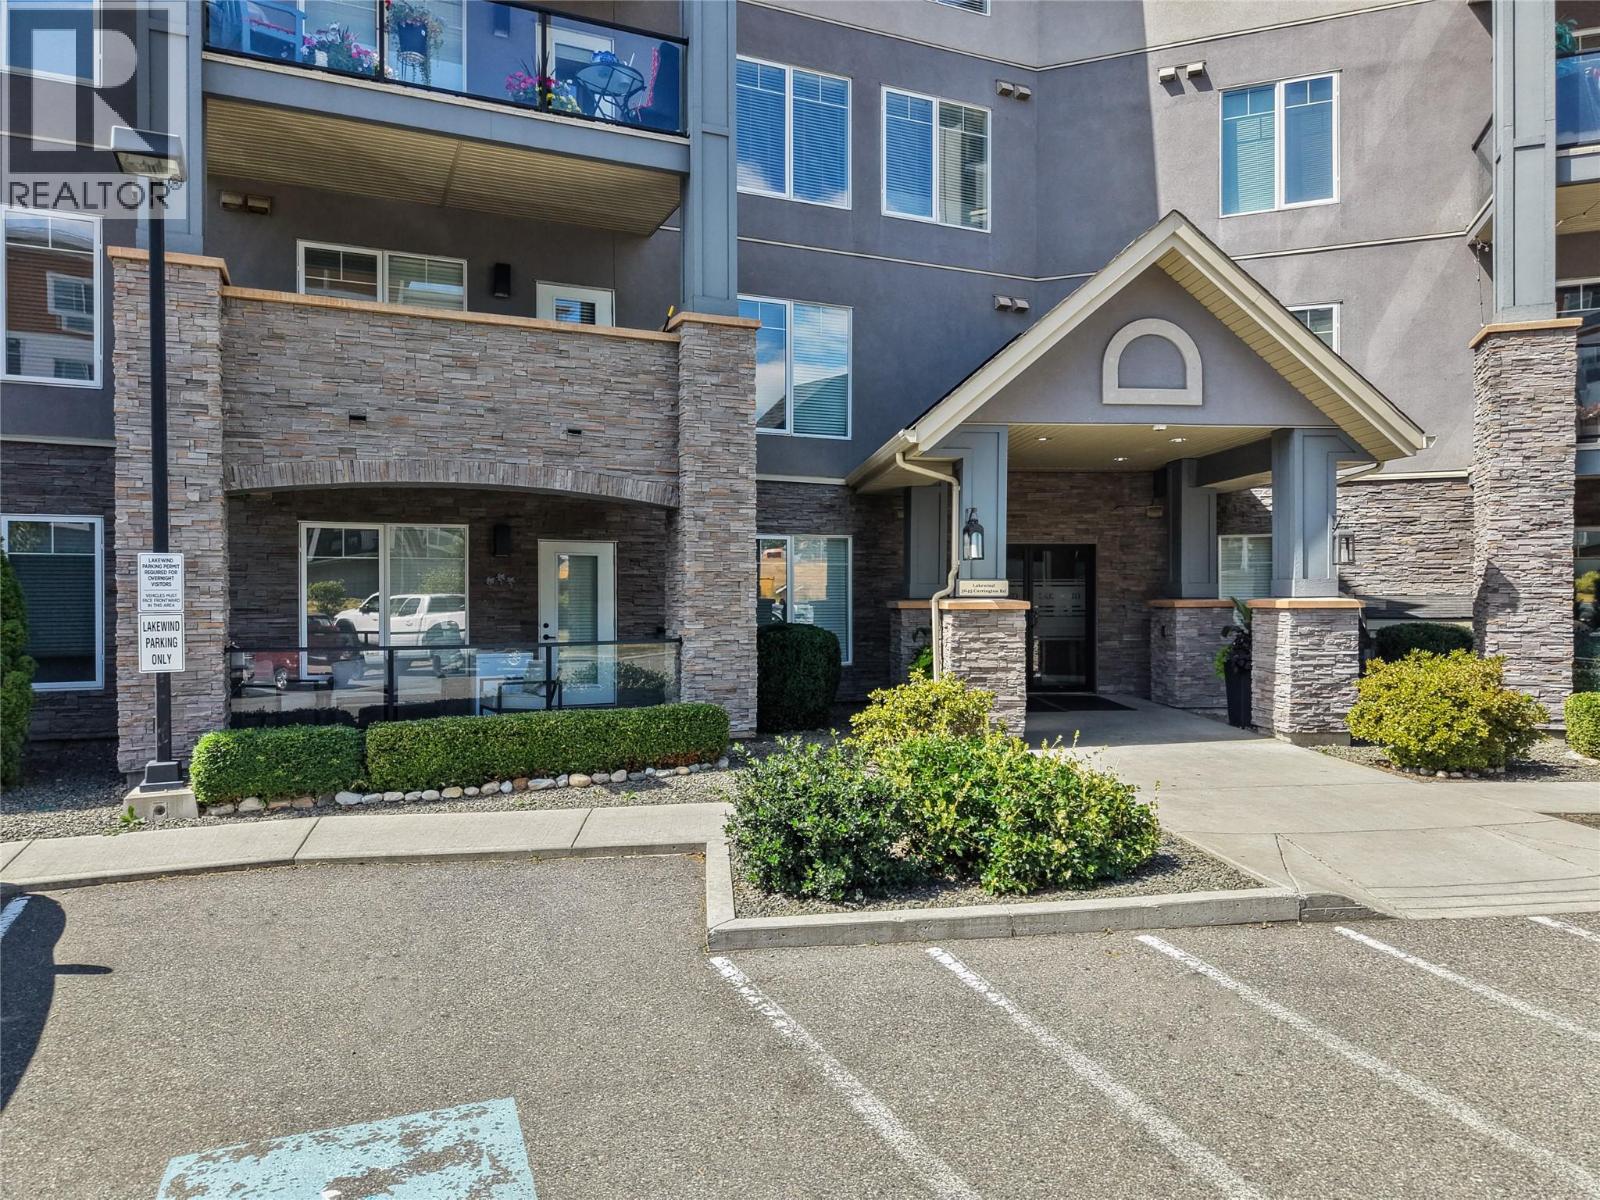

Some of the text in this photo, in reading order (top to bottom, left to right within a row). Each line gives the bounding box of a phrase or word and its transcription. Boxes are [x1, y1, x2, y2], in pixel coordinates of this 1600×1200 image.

[143, 621, 180, 632] LAKEWIND
[145, 637, 178, 648] PARKING
[151, 654, 172, 665] ONLY
